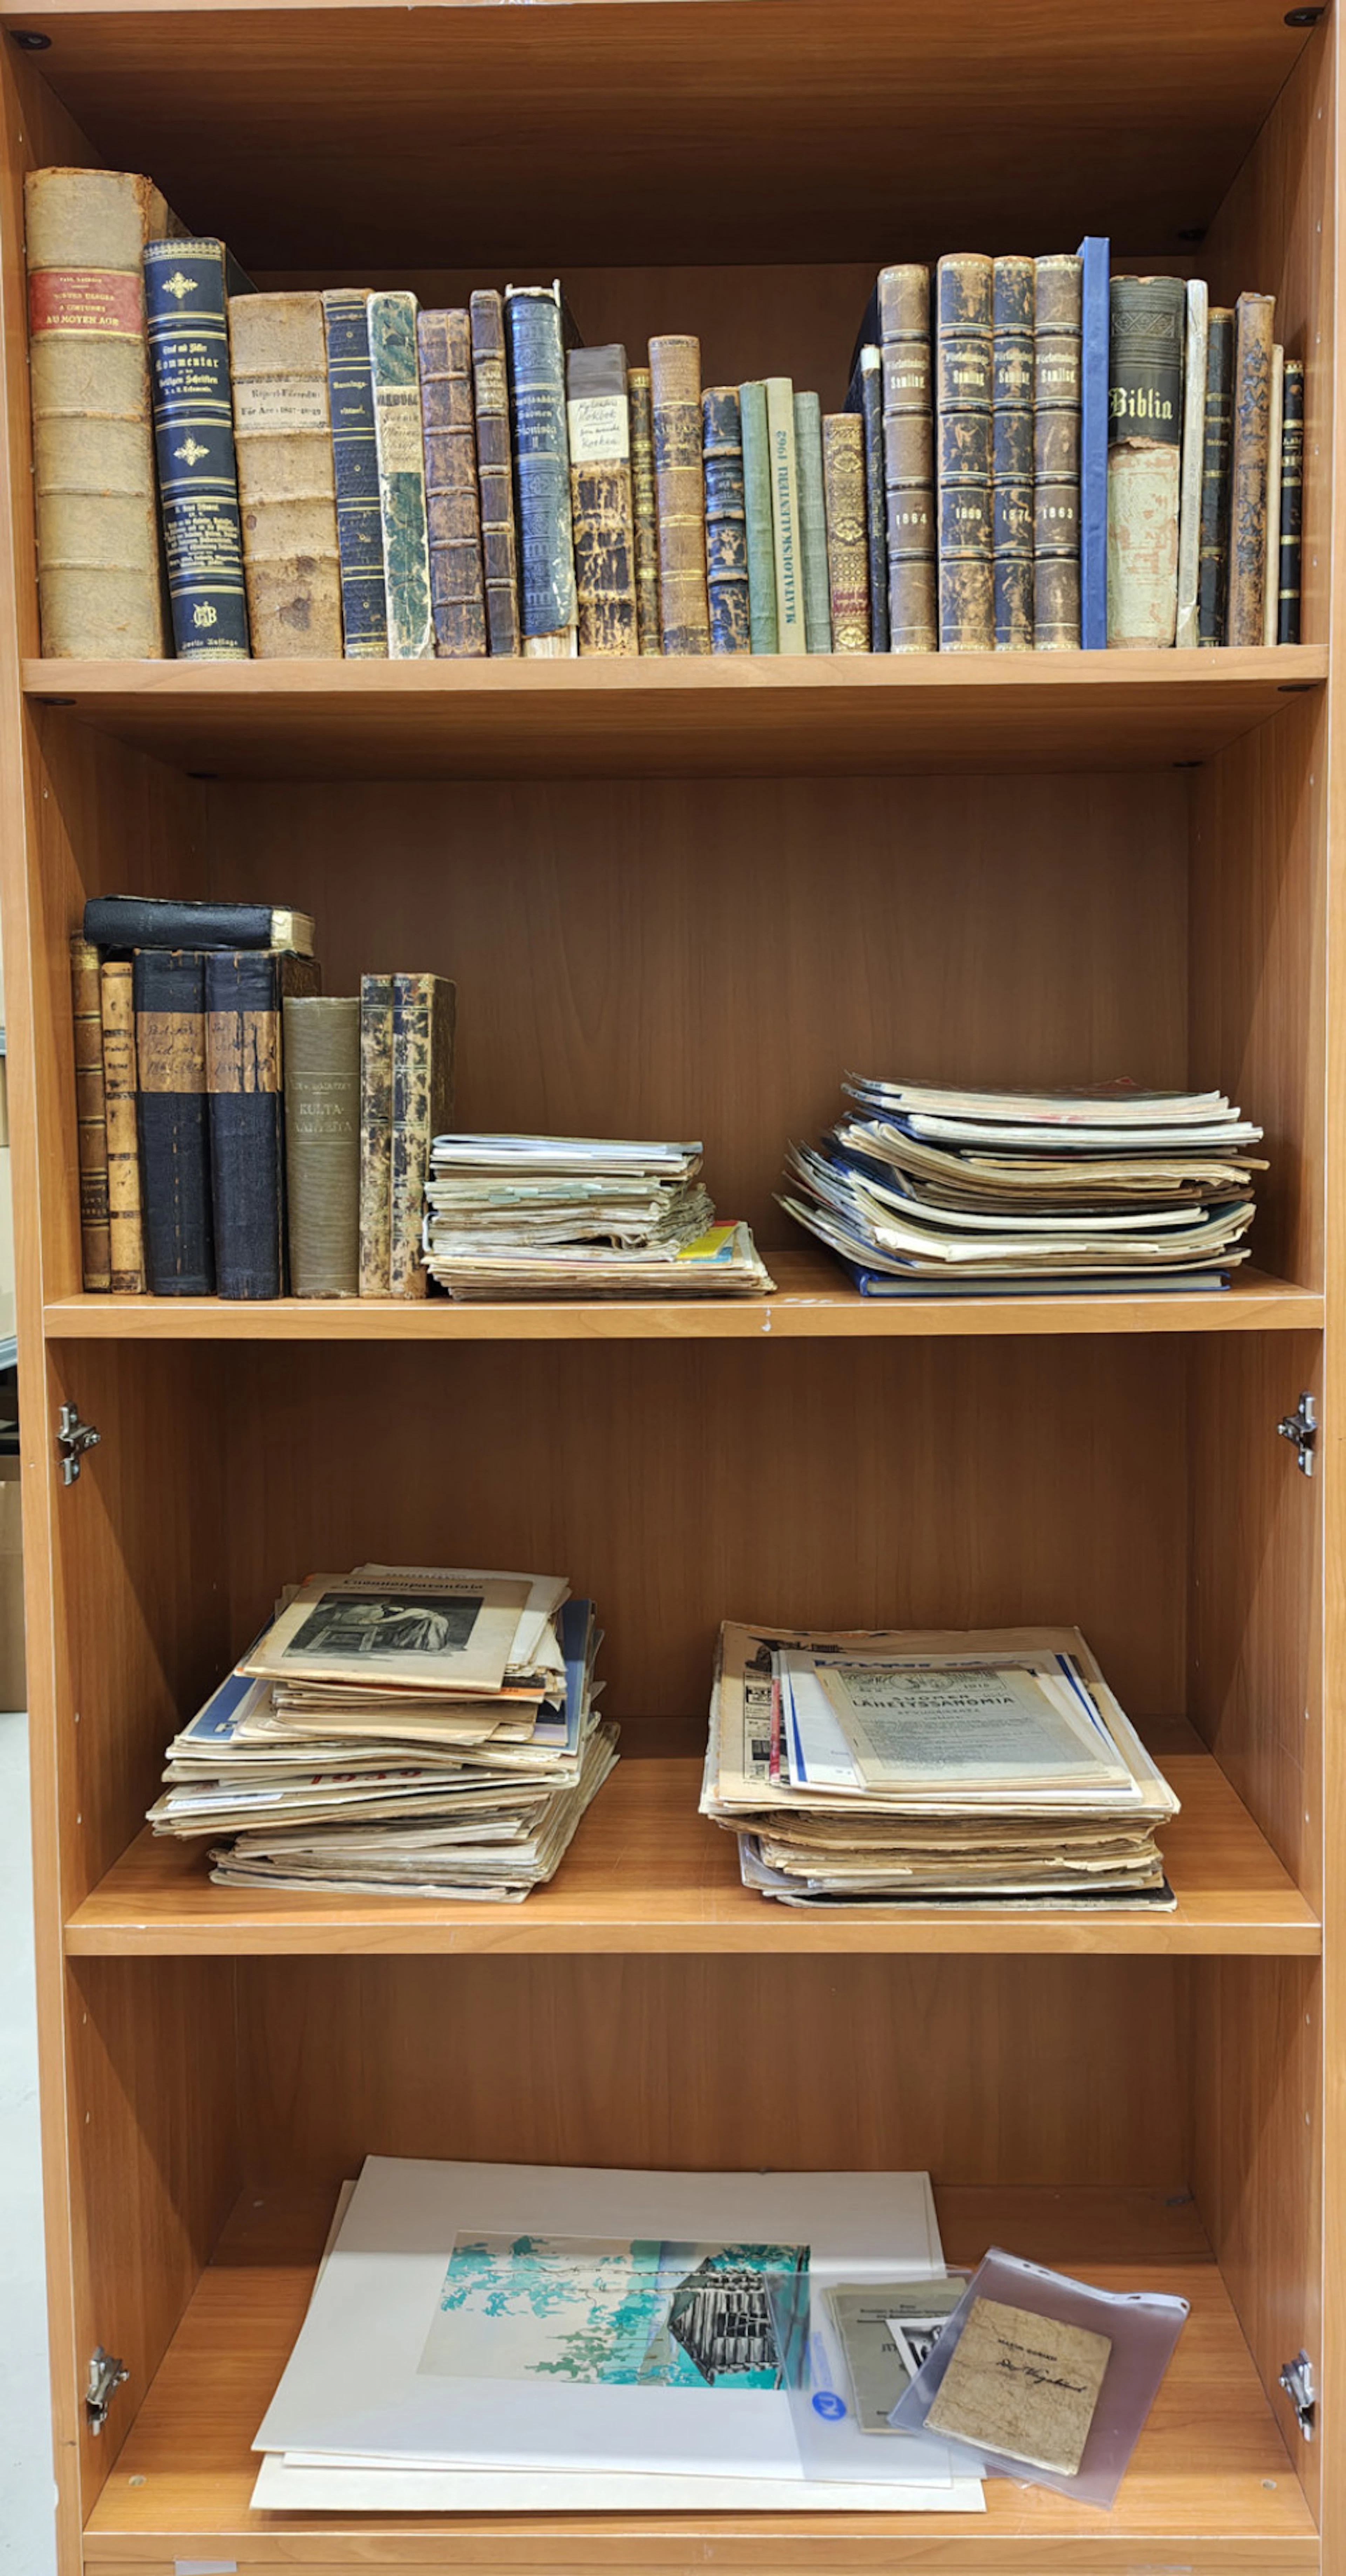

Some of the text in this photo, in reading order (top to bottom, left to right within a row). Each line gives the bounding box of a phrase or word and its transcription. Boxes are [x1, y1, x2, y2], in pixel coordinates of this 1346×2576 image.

[46, 316, 60, 324] AU
[1108, 387, 1174, 420] Biblia
[896, 513, 927, 525] 1864
[1042, 507, 1074, 519] 1863
[776, 430, 797, 623] MAATALOUSKALENTERI 1962
[853, 1697, 1015, 1709] LÄHETYSSANOMIA
